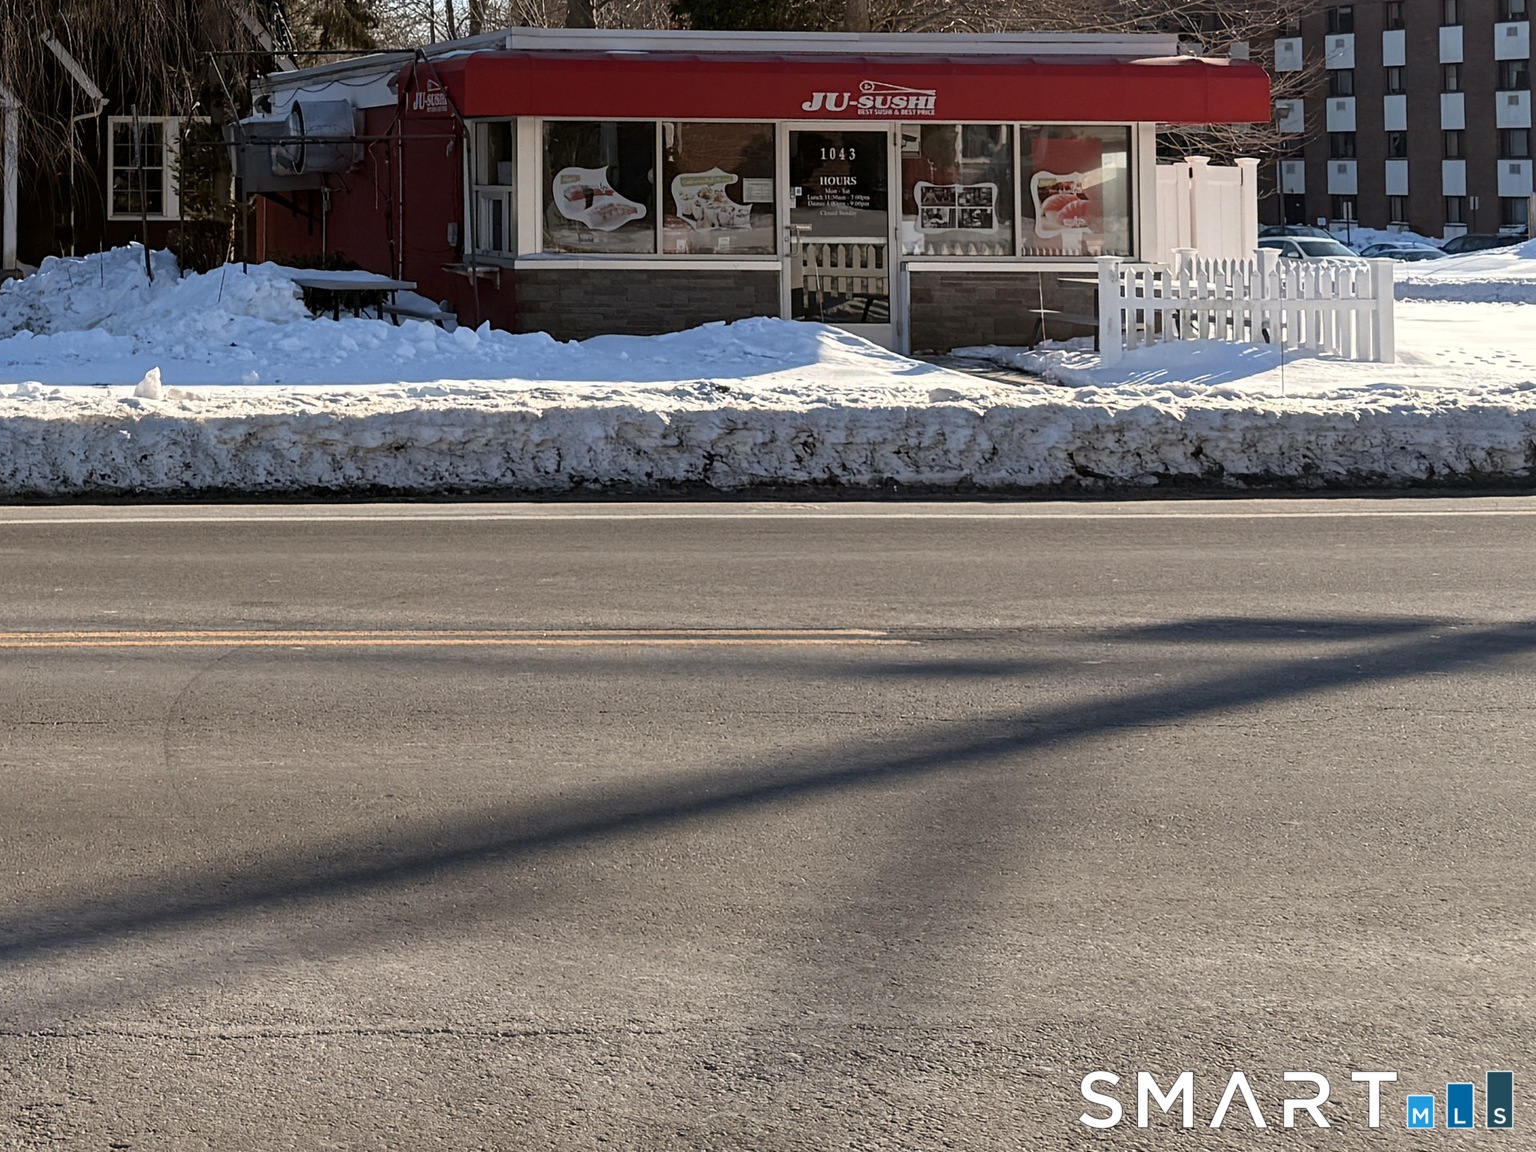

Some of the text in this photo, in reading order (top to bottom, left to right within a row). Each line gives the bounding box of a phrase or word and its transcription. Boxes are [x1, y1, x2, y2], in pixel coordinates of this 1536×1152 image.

[801, 92, 937, 112] JU-SUSHI
[820, 147, 856, 161] 1043
[820, 176, 857, 186] HOURS
